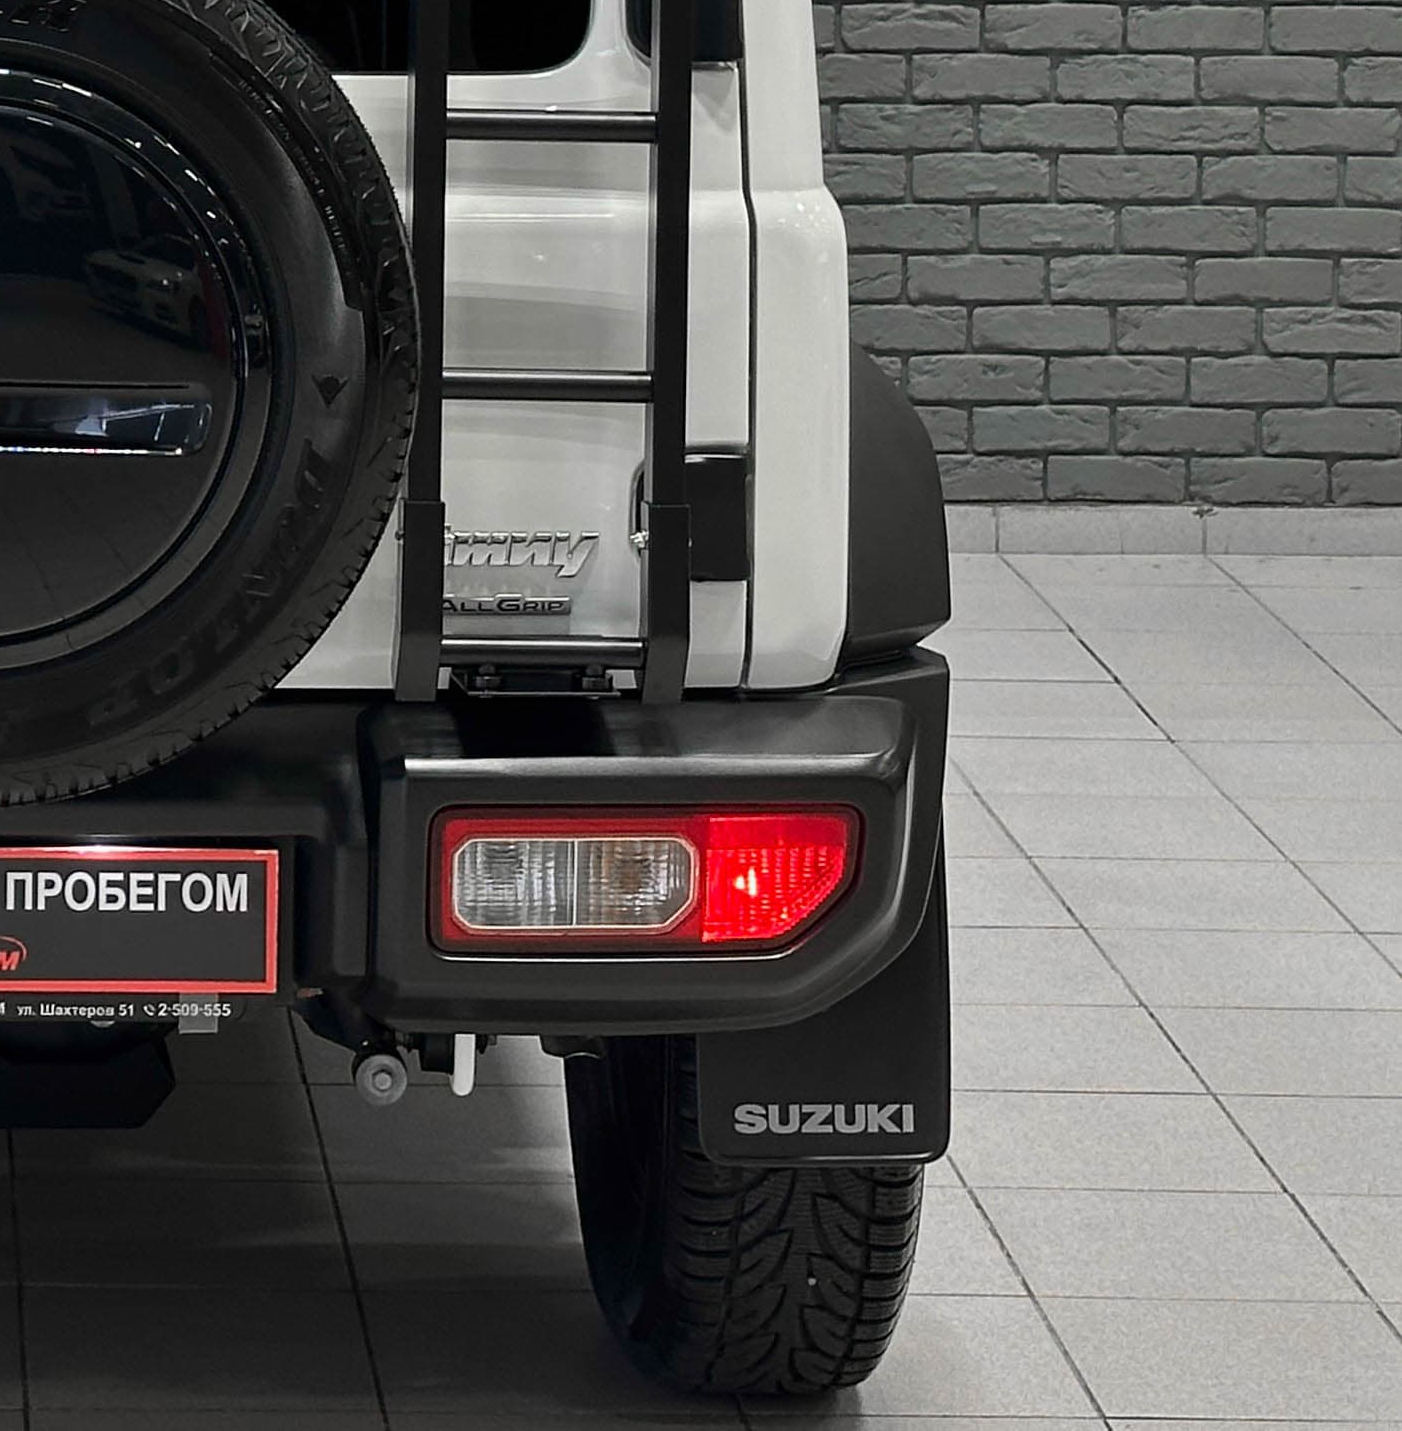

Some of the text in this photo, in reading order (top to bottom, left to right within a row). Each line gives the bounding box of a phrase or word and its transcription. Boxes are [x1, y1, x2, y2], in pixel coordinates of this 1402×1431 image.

[6, 871, 248, 913] ПРОБЕГОМ
[17, 1005, 36, 1017] ул.
[40, 1003, 115, 1018] Шахтеров
[118, 1004, 135, 1017] 51
[733, 1103, 915, 1135] SUZUKI
